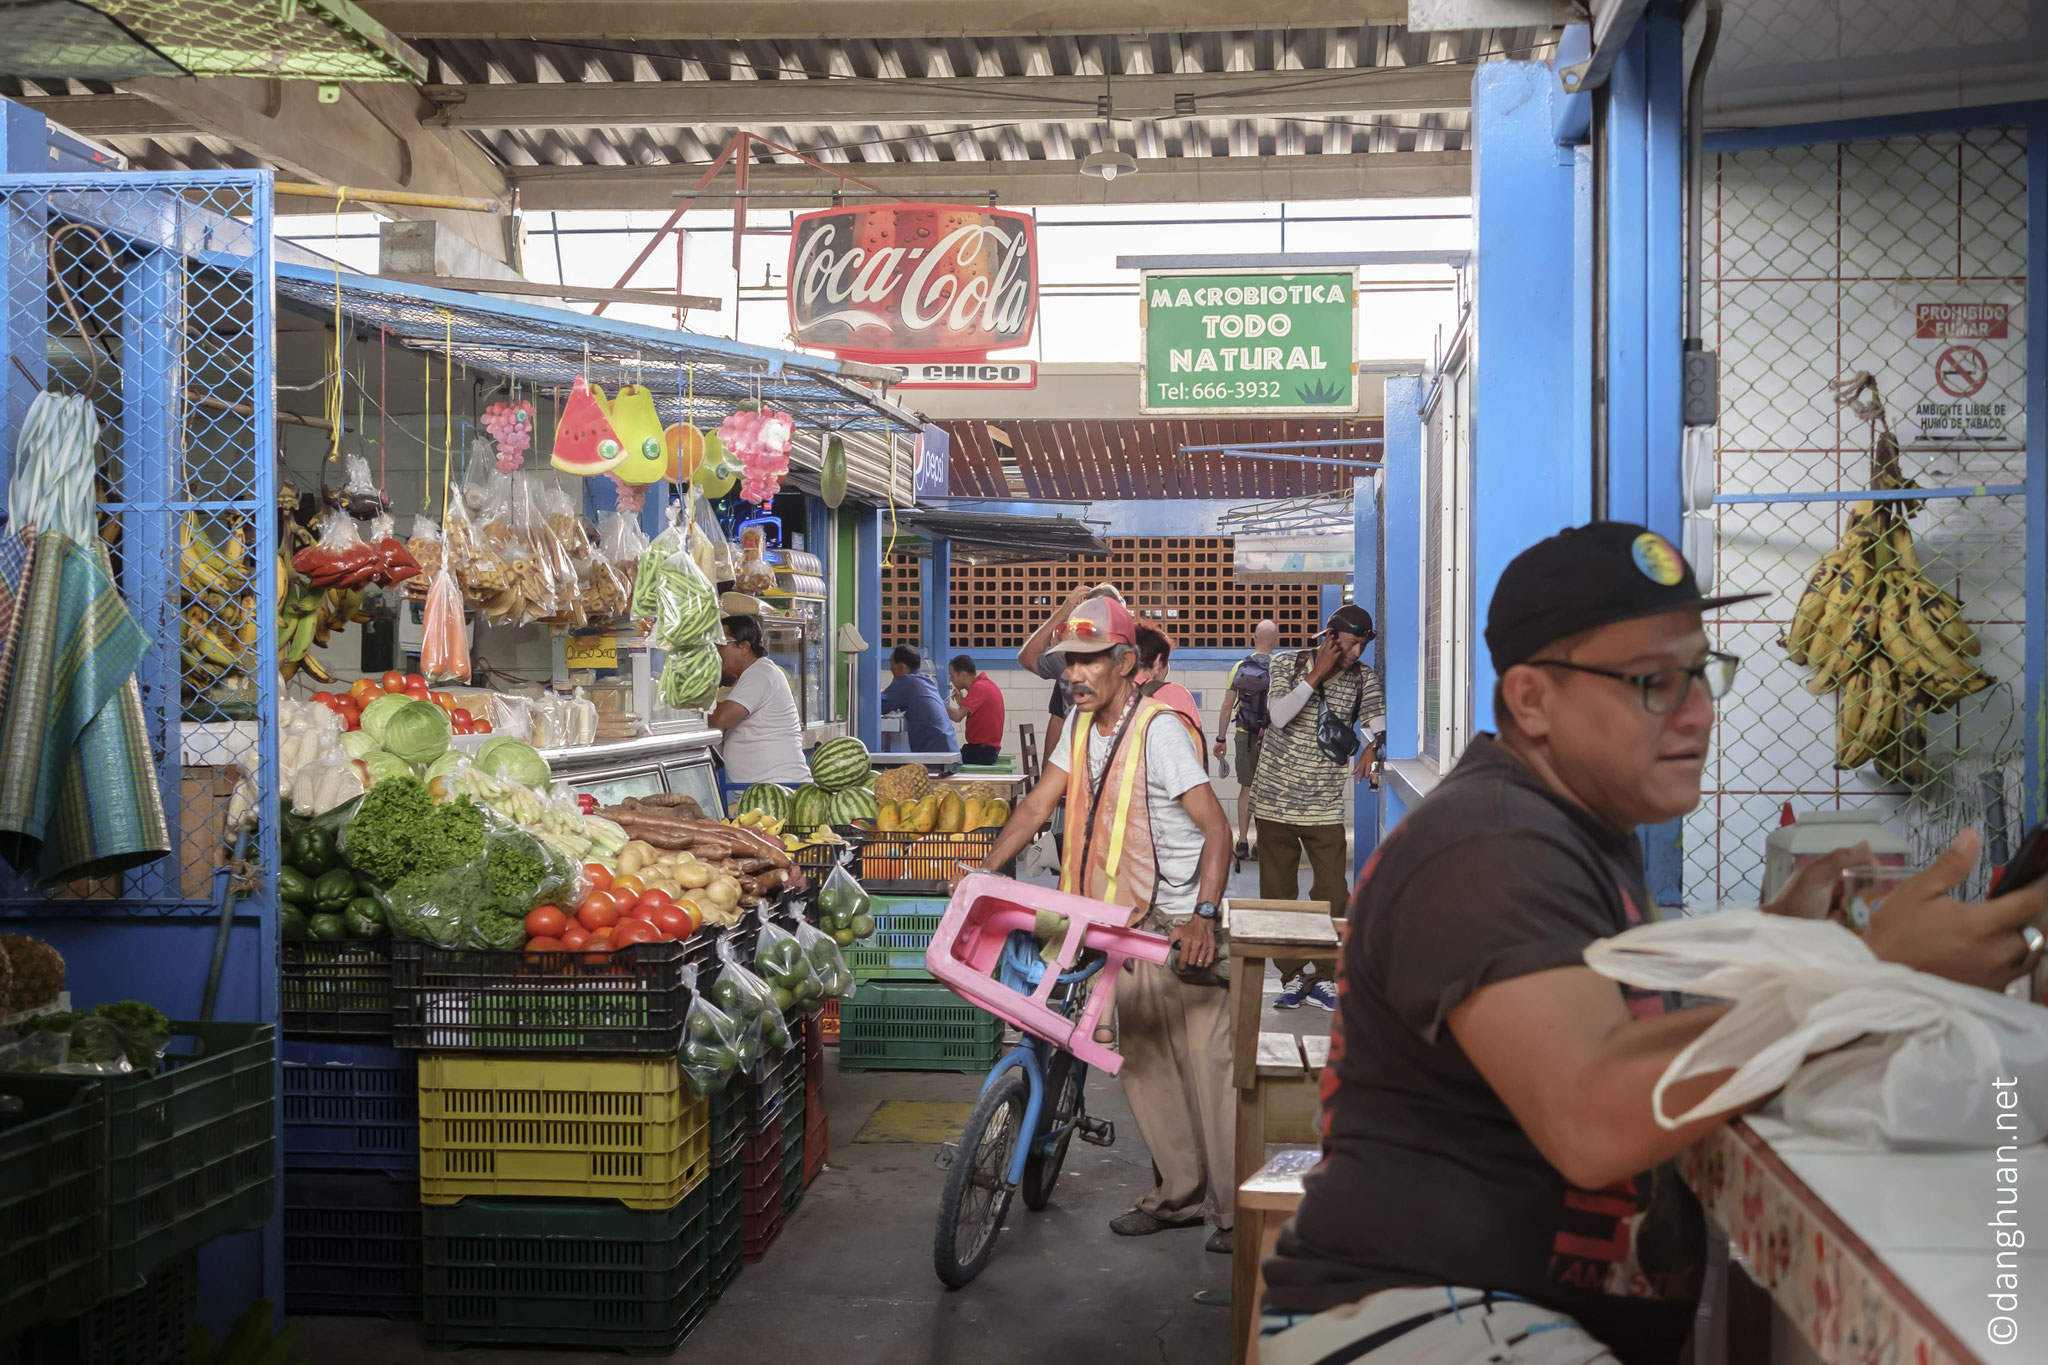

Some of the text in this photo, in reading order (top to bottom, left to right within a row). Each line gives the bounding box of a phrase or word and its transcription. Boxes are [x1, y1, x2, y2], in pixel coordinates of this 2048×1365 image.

[793, 223, 1028, 334] Coca-Cola
[1150, 284, 1346, 308] MACROBIOTICA
[1920, 305, 2006, 320] PROHIBIDO
[1201, 313, 1292, 339] TODO
[1935, 322, 1990, 337] FUMAR
[1169, 345, 1328, 373] NATURAL
[922, 365, 1021, 381] CHICO
[1192, 381, 1281, 400] 666-3932
[1916, 403, 2006, 416] AMBIENTE LIBRE DE
[1920, 417, 2001, 430] HUMO DE TABACO
[925, 450, 944, 487] pepsi
[565, 645, 594, 660] Queso
